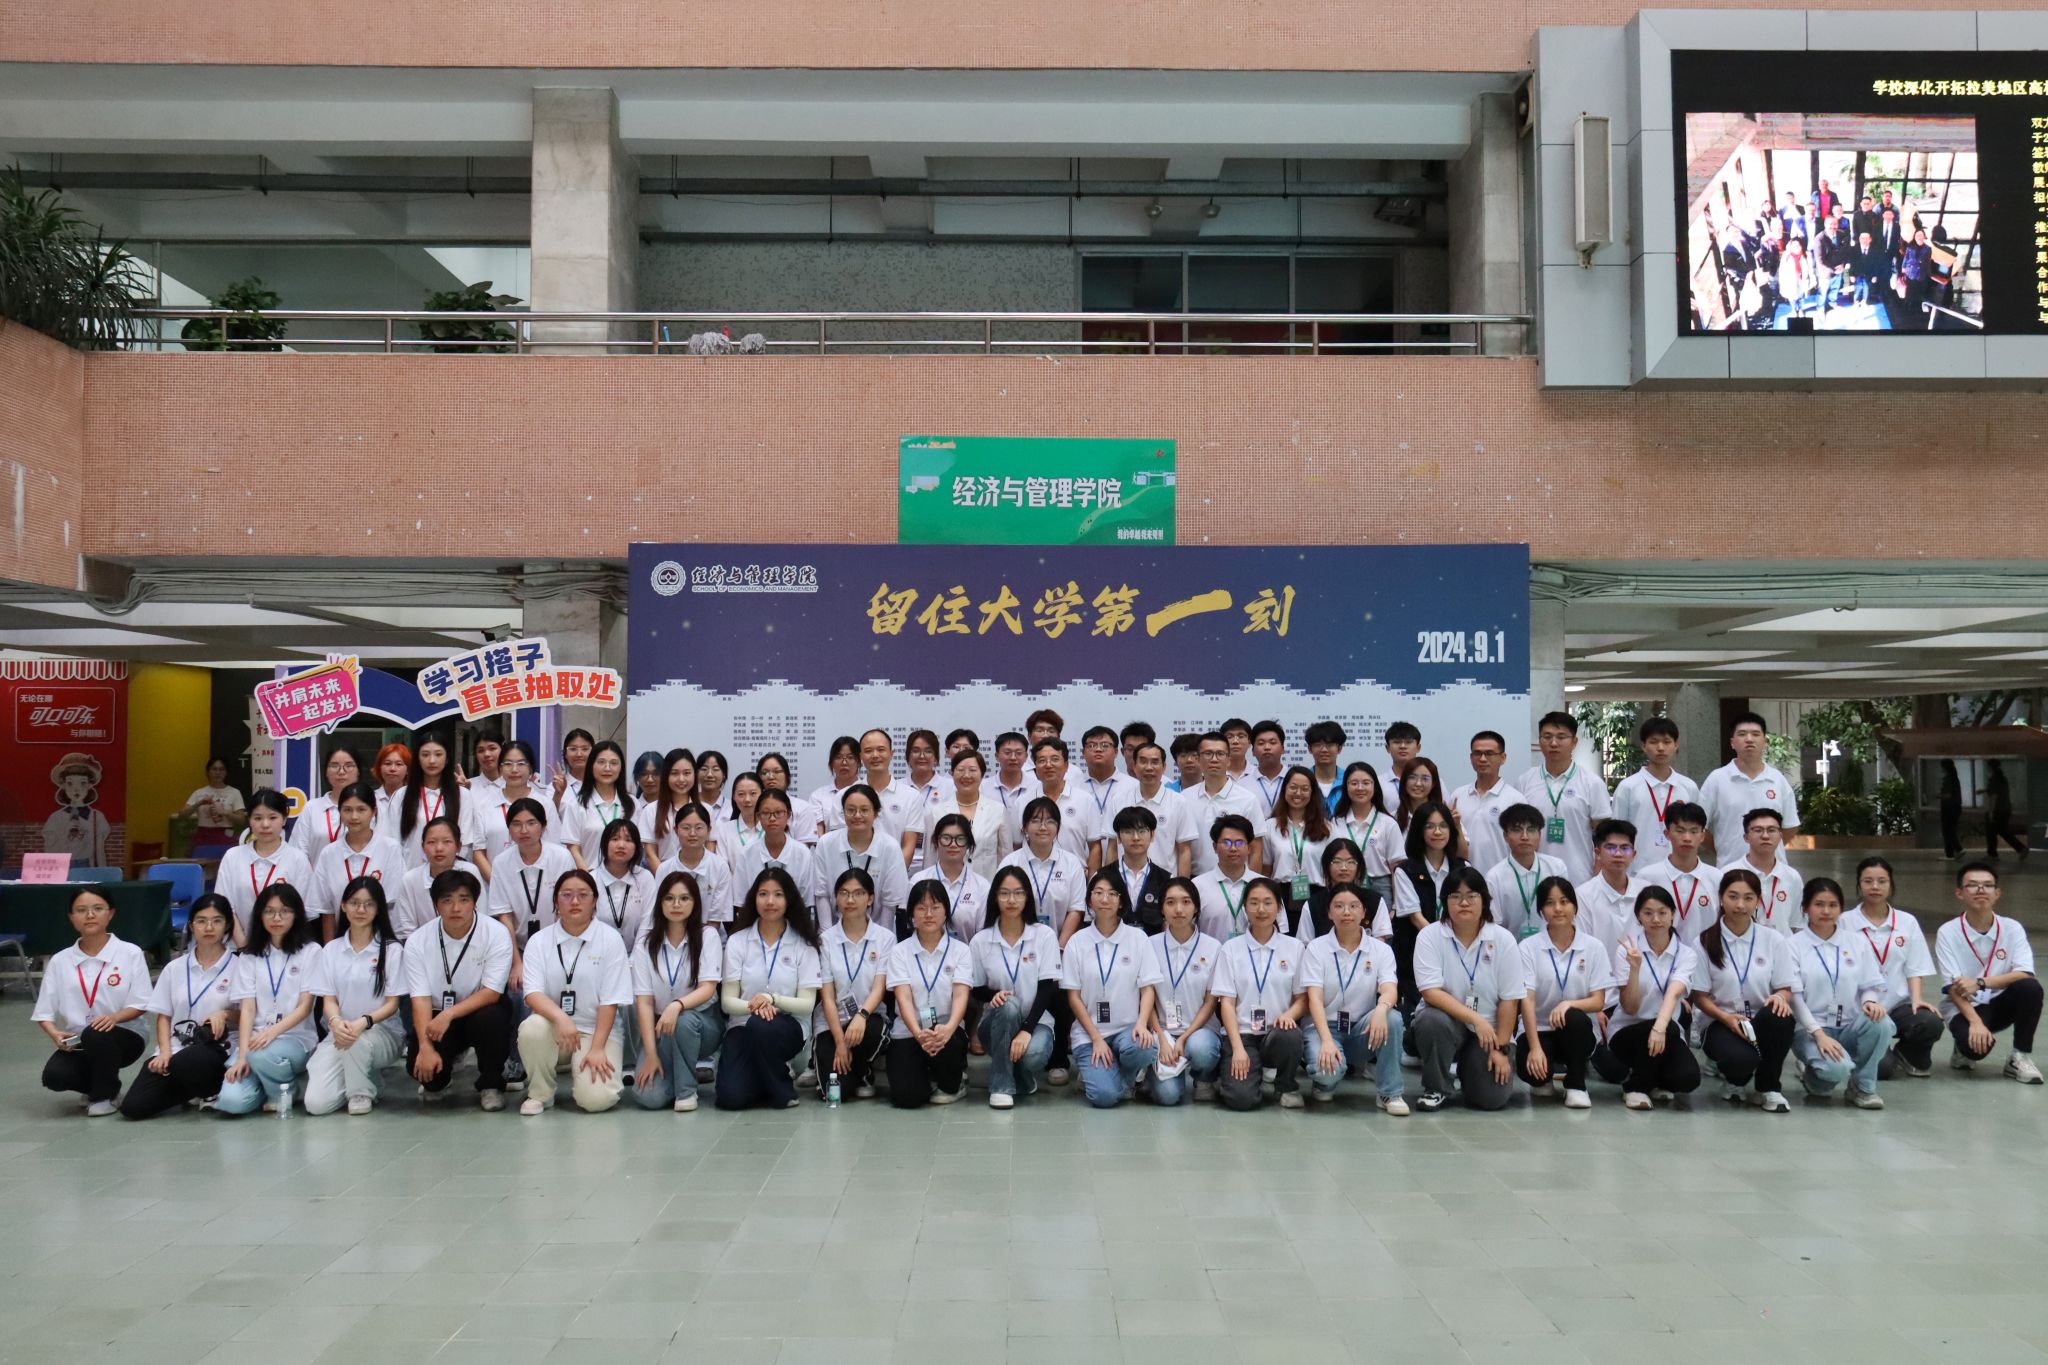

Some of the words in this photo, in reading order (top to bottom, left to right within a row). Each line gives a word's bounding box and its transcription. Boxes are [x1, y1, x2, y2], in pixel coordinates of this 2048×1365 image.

[952, 476, 1122, 508] 经济与管理学院
[691, 565, 817, 585] 经济与管理学院
[867, 581, 1296, 638] 留住大学第一刻
[1418, 631, 1505, 663] 2024.9.1
[423, 643, 544, 697] 学习搭子
[275, 678, 341, 709] 并肩未来
[287, 694, 353, 720] 一起发光
[461, 672, 616, 714] 盲盒抽取处
[29, 705, 100, 727] 可口可乐
